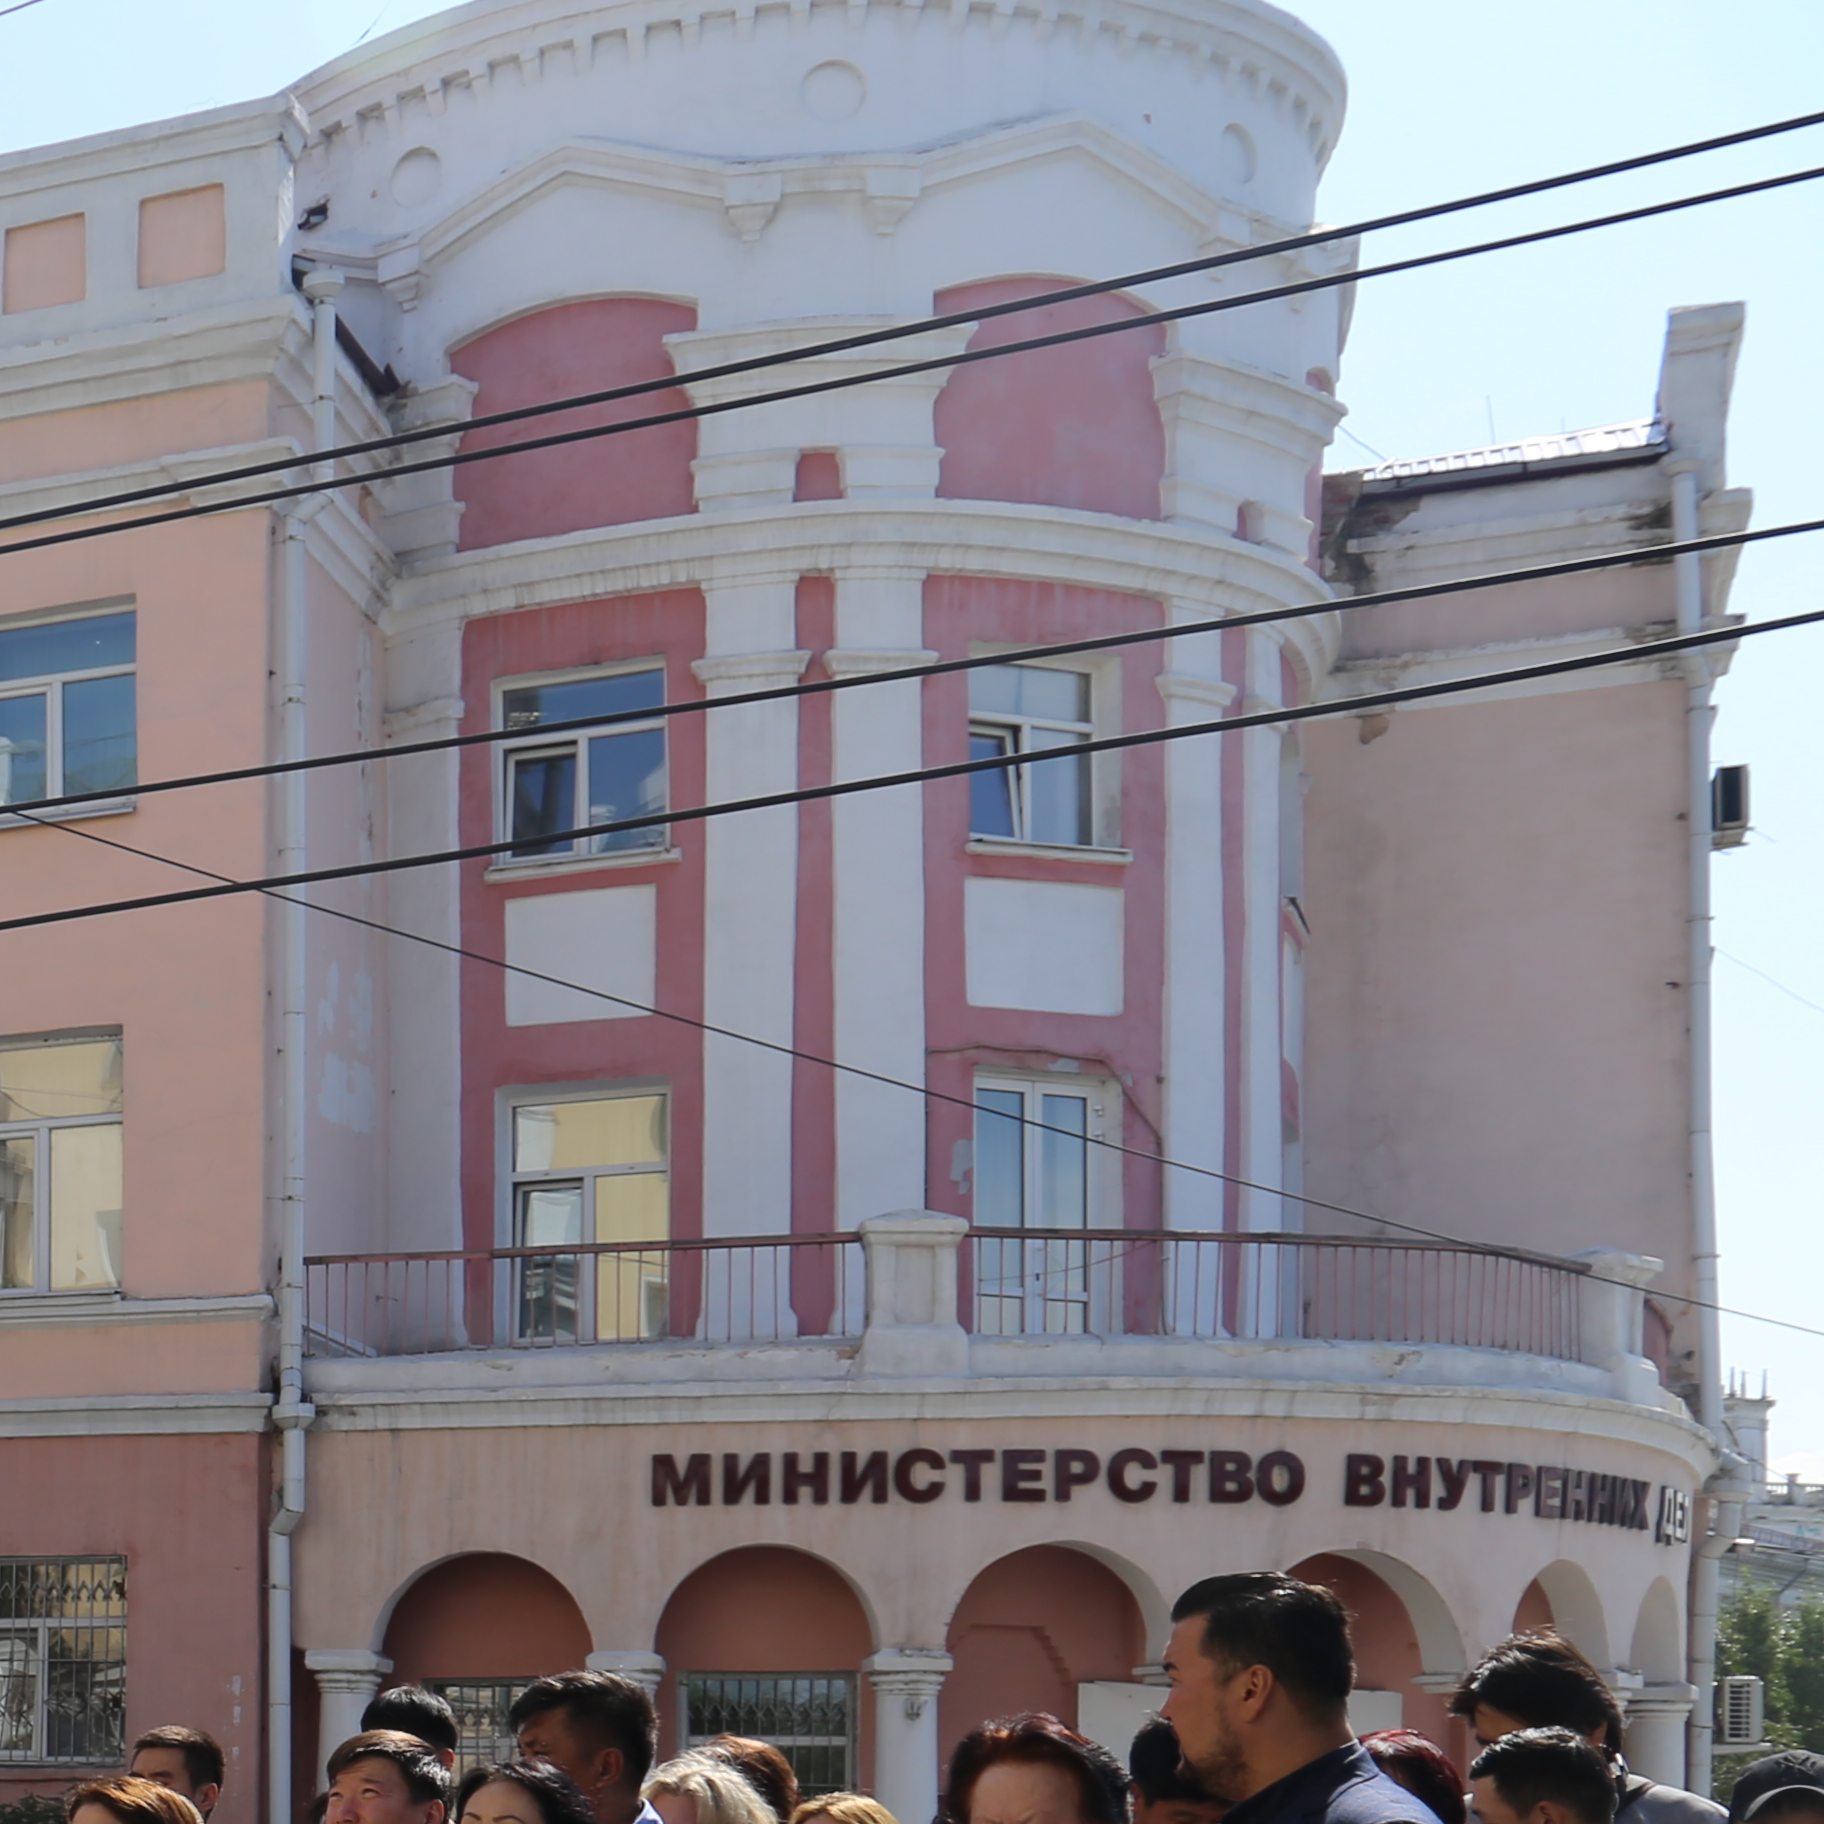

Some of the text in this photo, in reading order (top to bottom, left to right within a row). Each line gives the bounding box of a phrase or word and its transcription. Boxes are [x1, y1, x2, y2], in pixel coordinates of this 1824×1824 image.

[649, 1447, 1689, 1546] МИНИСТЕРСТВО ВНУТРЕННИХ ДЕ
